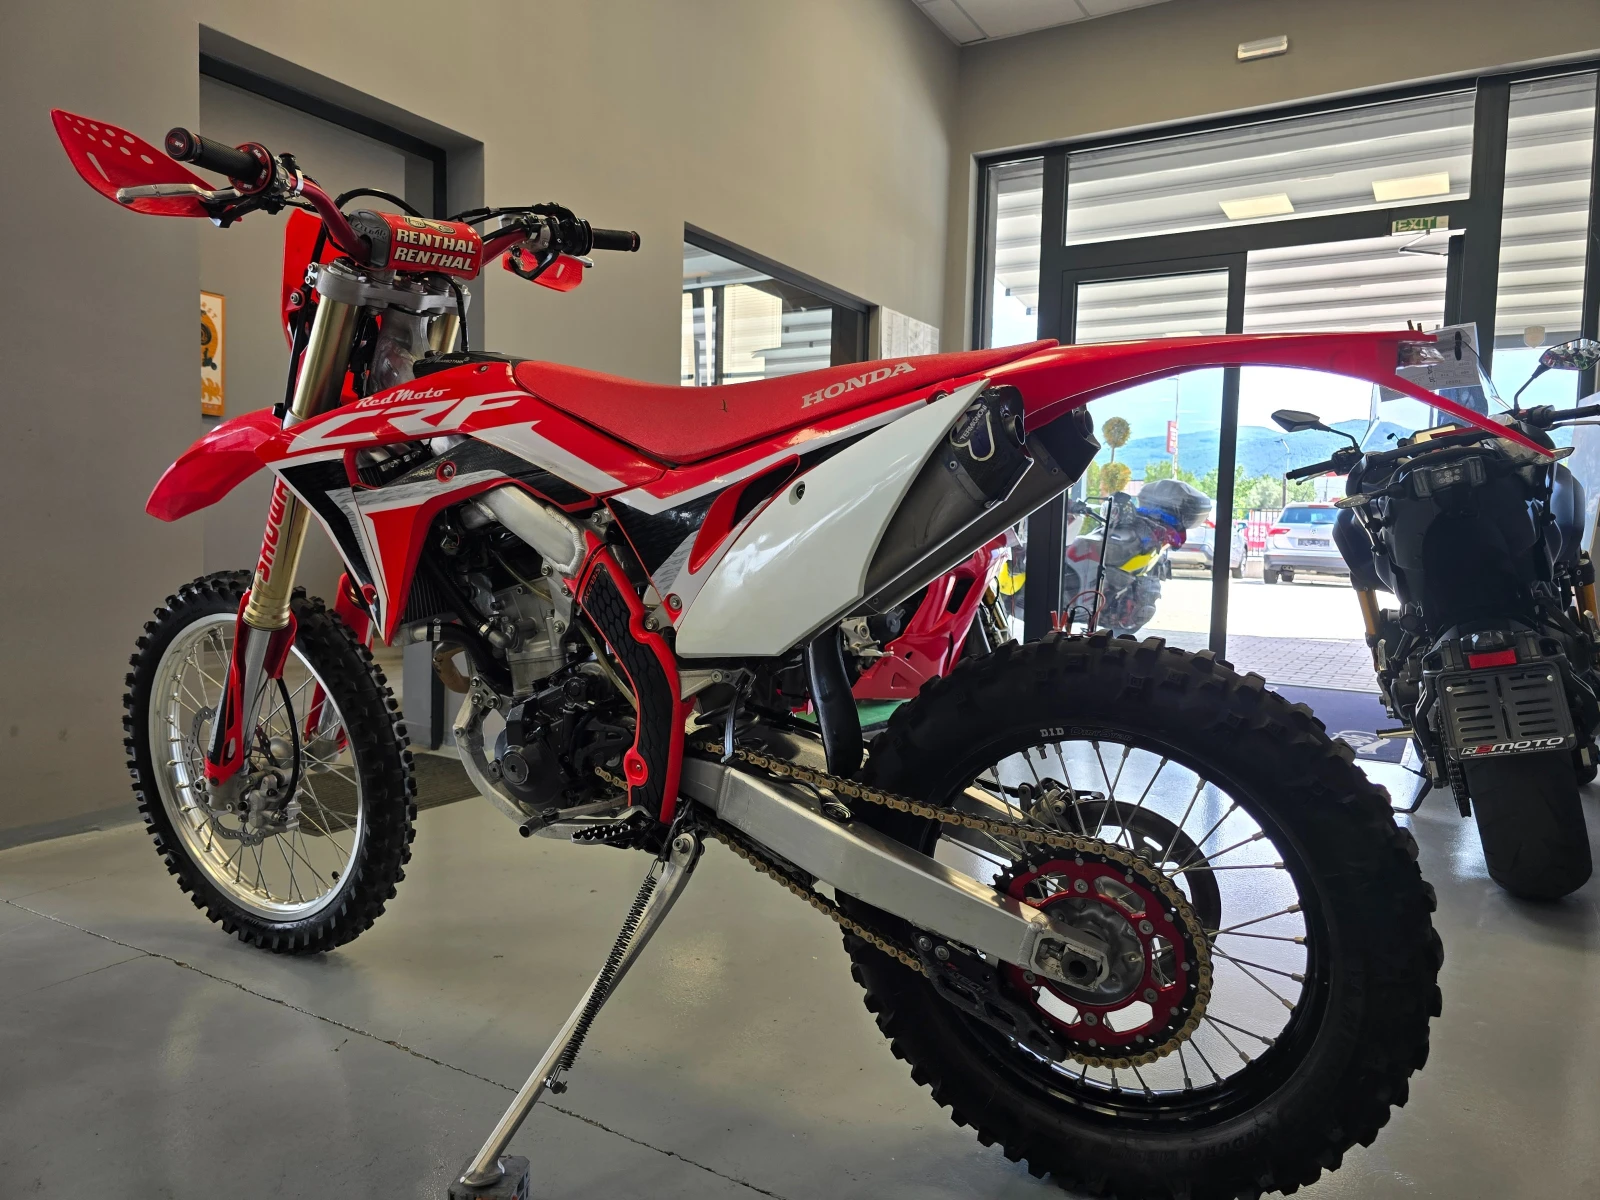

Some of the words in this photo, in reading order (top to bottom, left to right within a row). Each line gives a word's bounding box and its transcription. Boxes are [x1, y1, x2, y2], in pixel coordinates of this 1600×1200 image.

[1397, 216, 1436, 232] EXIT
[396, 228, 477, 255] RENTHAL
[394, 246, 473, 271] RENTHAL
[801, 362, 917, 409] HONDA
[286, 390, 538, 454] CRF
[959, 404, 988, 440] TERMIGNONI
